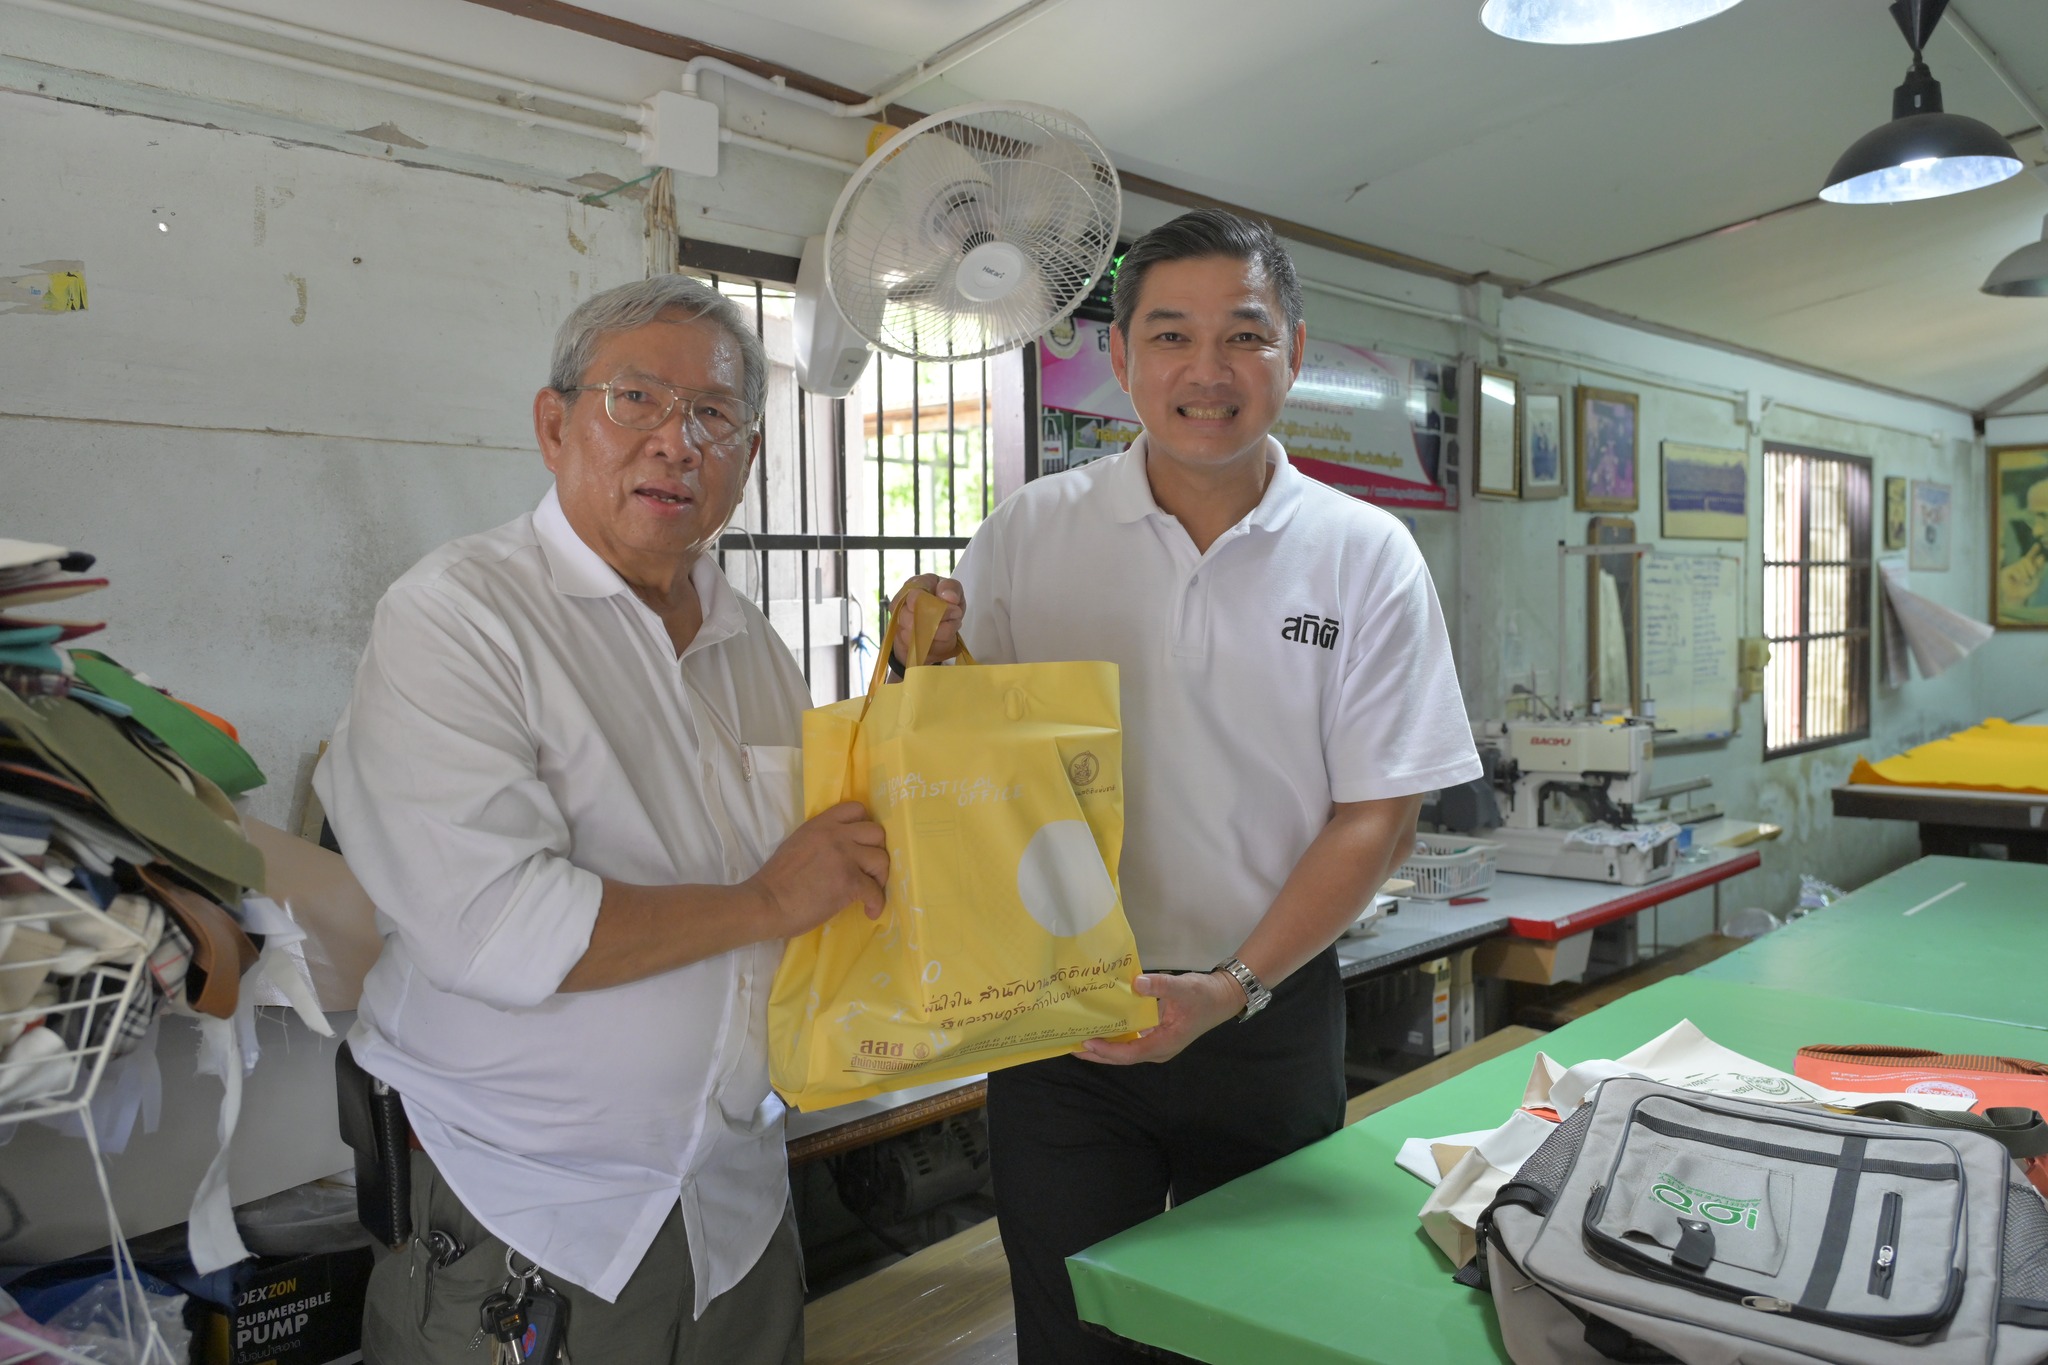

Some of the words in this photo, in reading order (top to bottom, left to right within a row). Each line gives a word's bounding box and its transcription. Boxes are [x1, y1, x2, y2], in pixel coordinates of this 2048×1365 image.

[1281, 613, 1339, 651] สถิติ
[860, 1039, 904, 1056] สสช
[237, 1291, 331, 1329] SUBMERSIBLE
[237, 1313, 309, 1350] PUMP
